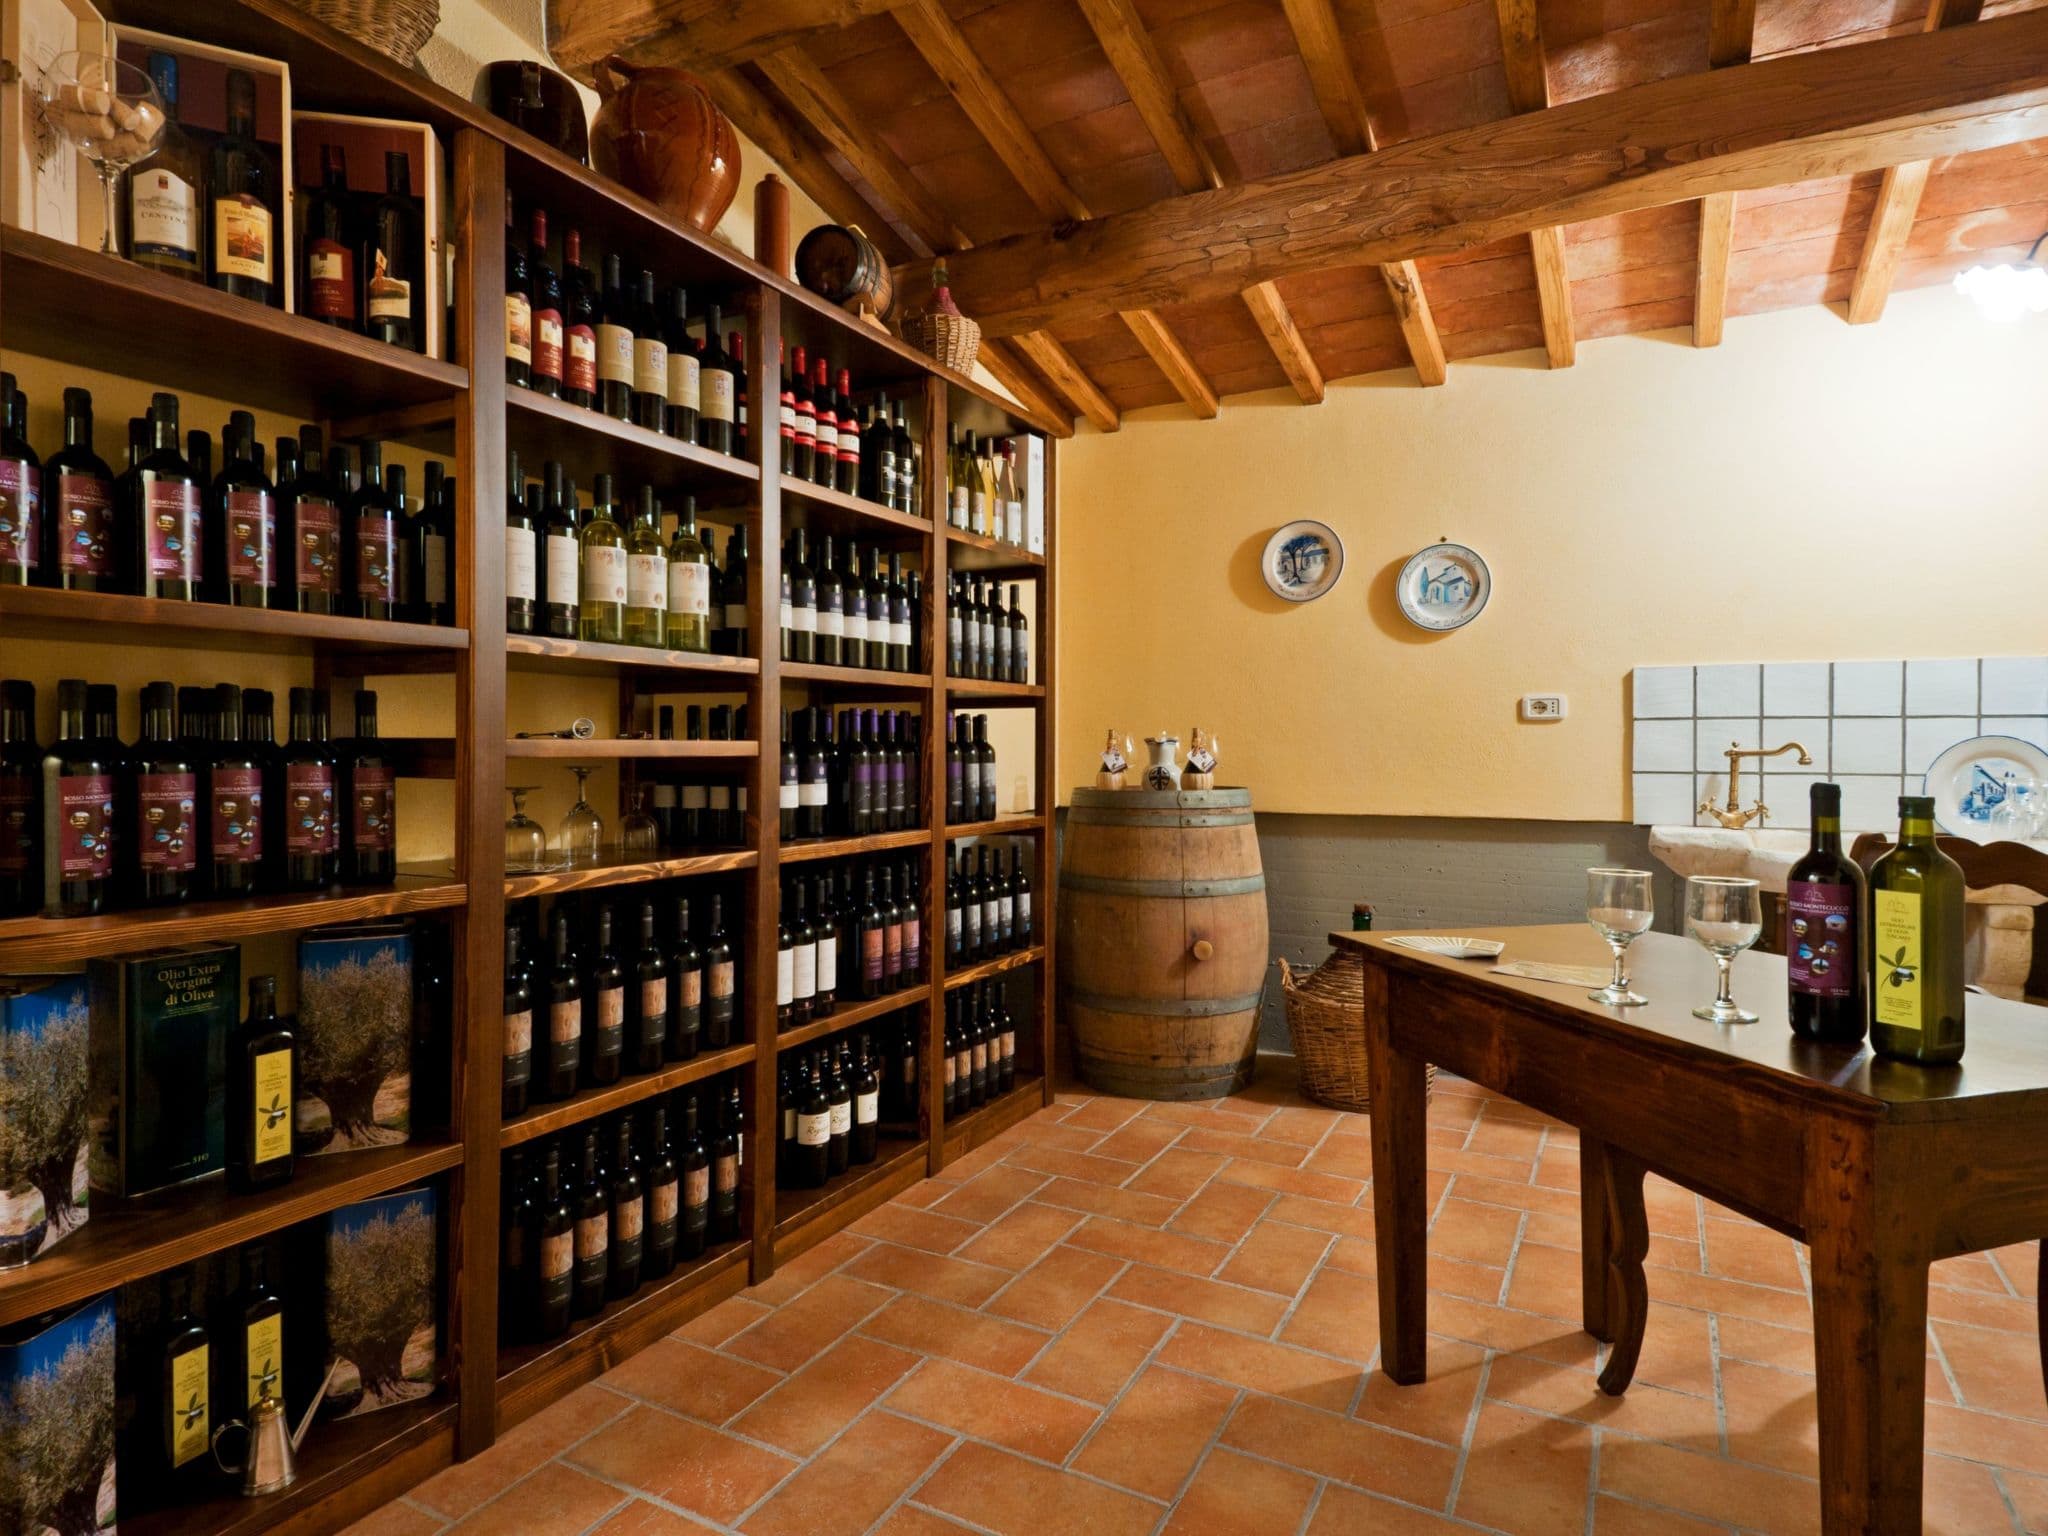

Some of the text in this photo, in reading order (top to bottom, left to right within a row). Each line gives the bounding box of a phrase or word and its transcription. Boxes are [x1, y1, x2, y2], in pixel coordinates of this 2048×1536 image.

[158, 965, 221, 982] Olio Extra
[167, 976, 214, 991] Vergine
[165, 990, 215, 1006] di Oliva
